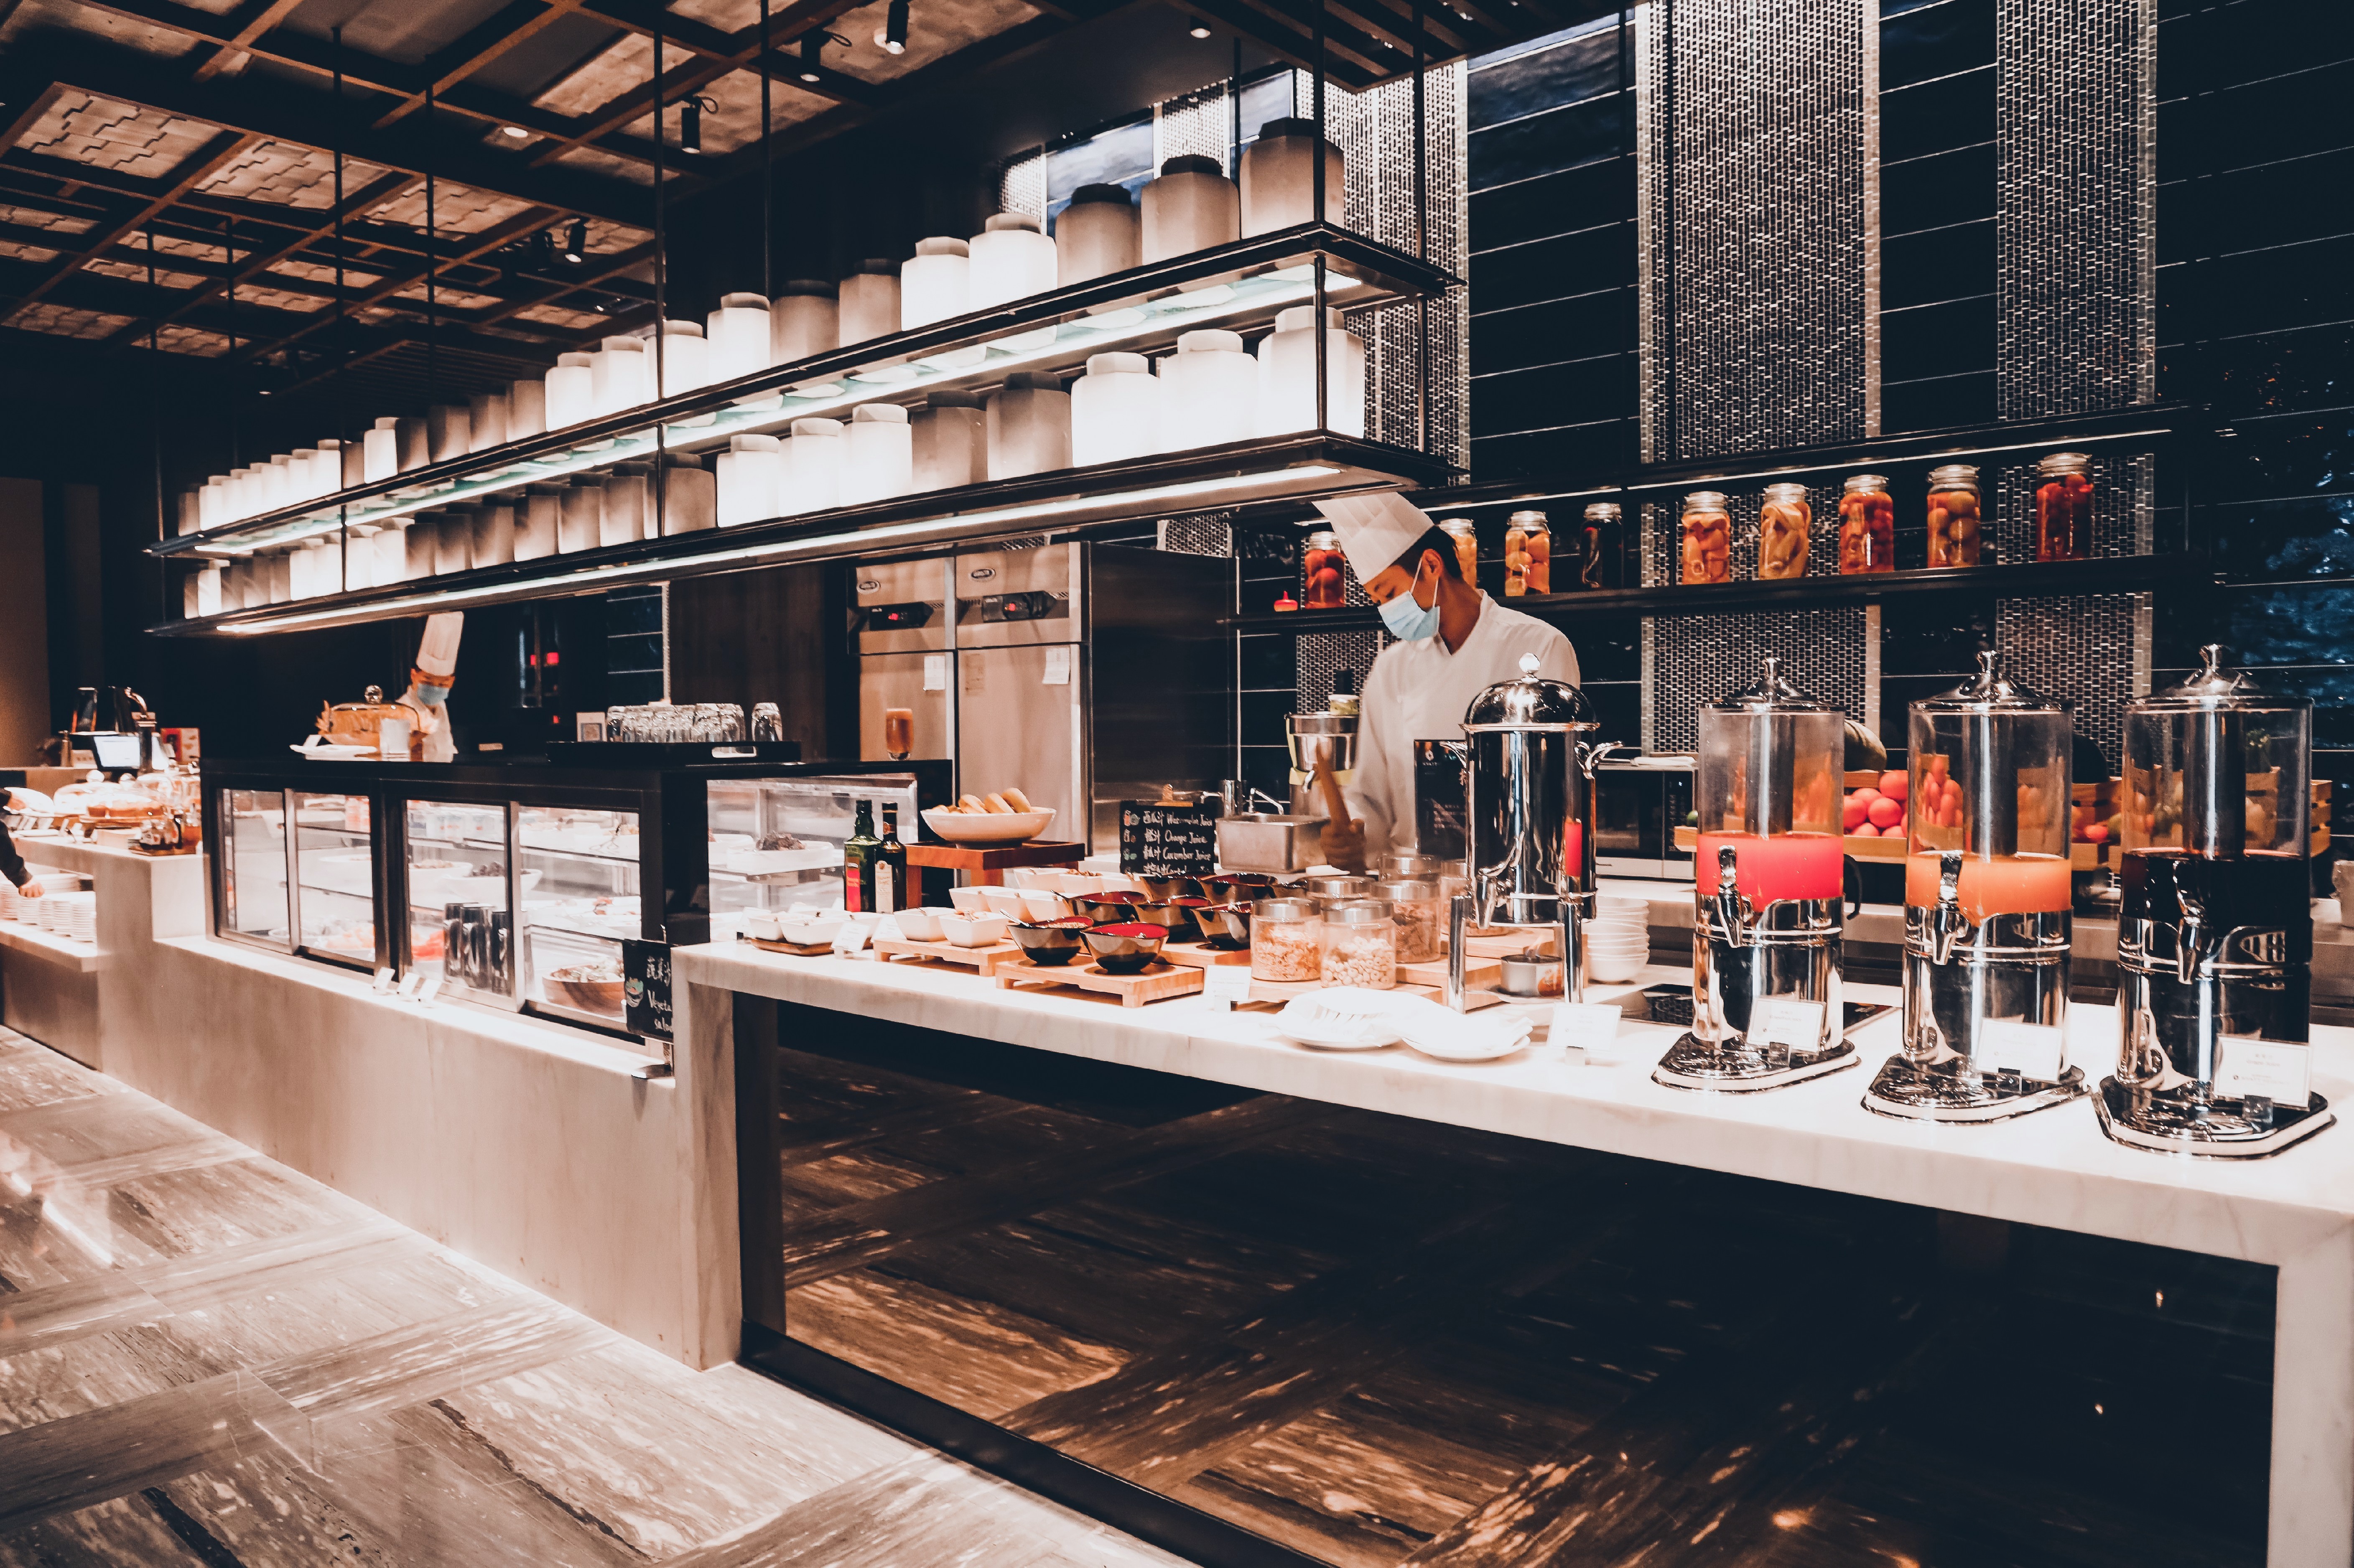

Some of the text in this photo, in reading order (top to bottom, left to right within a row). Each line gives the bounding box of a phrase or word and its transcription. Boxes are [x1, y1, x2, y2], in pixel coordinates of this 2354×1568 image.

[1165, 830, 1187, 845] Orange
[1189, 832, 1208, 844] Juice
[1163, 847, 1194, 860] Cucumber
[1195, 849, 1211, 861] Juice
